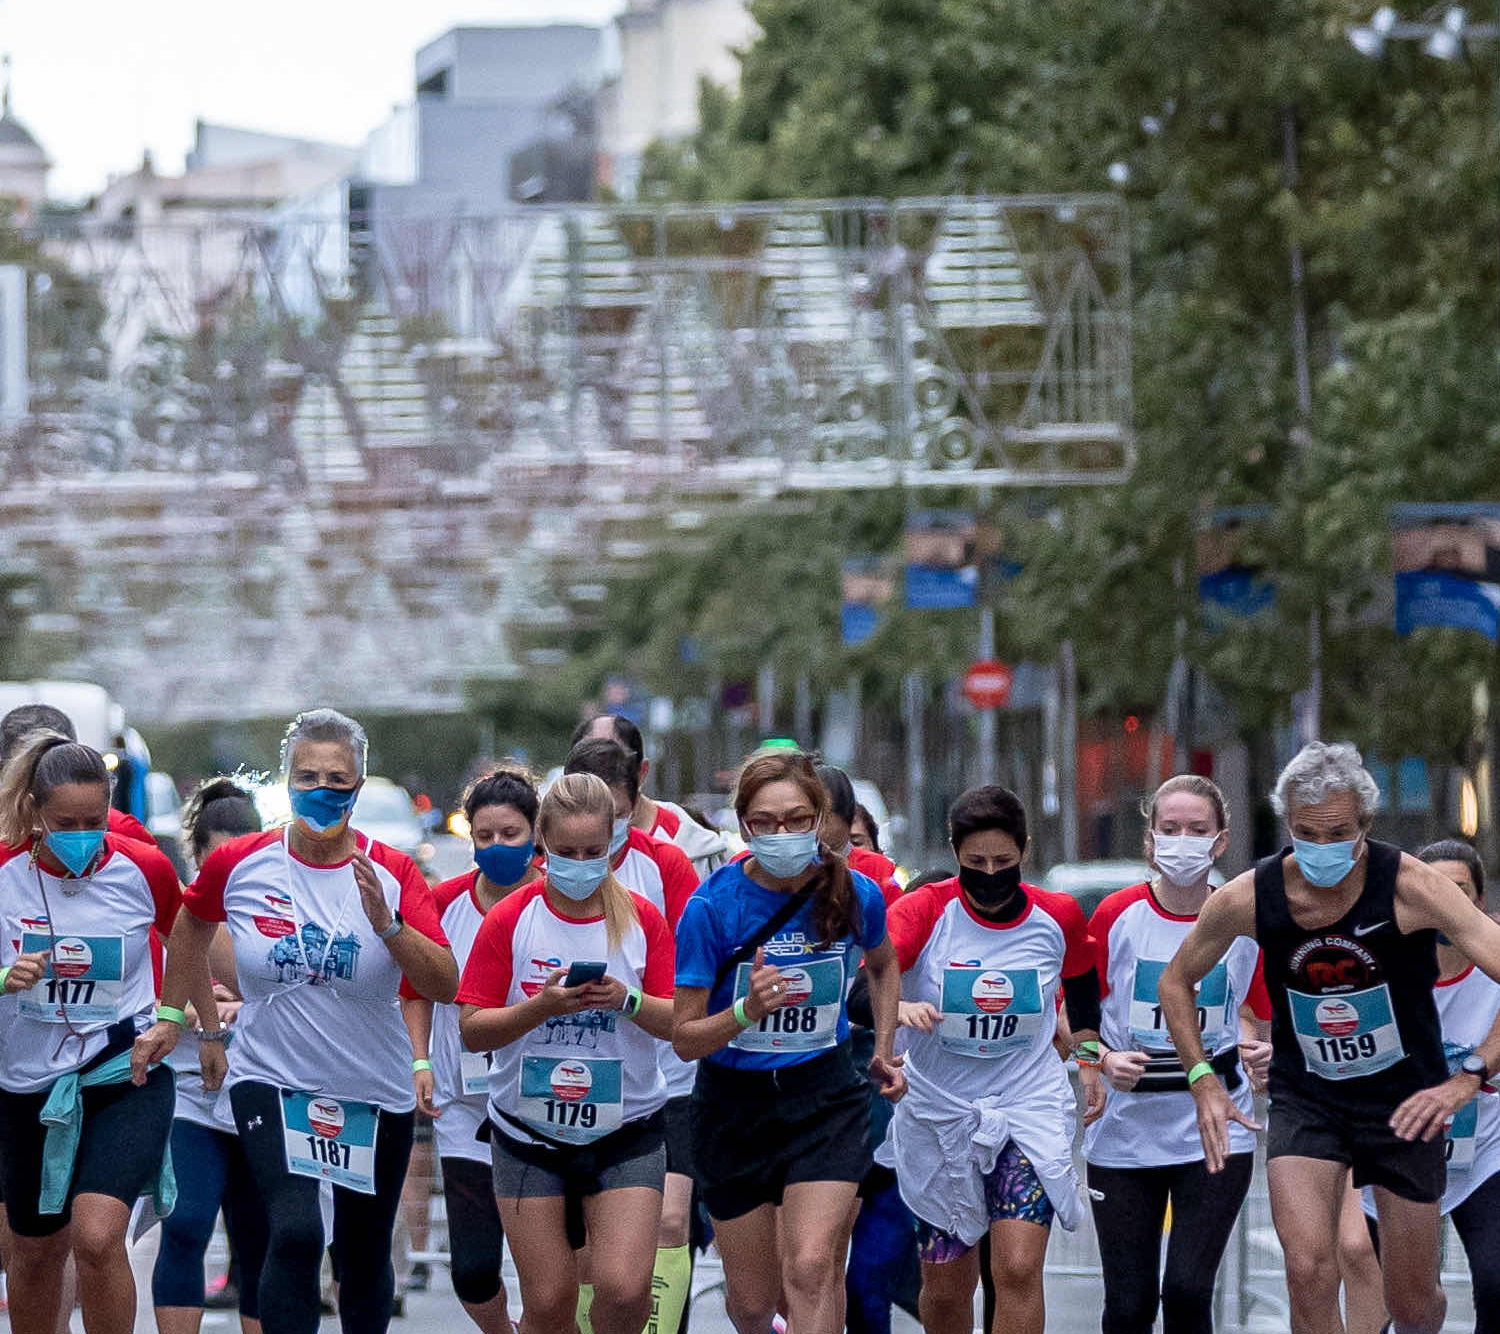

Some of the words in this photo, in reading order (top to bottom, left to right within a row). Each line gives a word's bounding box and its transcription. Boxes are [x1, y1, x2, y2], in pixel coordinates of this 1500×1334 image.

[1290, 938, 1323, 973] UNNING
[45, 979, 96, 1004] 1177
[759, 1006, 818, 1033] 1188
[965, 1014, 1019, 1040] 1178
[1315, 1033, 1377, 1063] 1159
[544, 1099, 597, 1128] 1179
[306, 1135, 351, 1170] 1187
